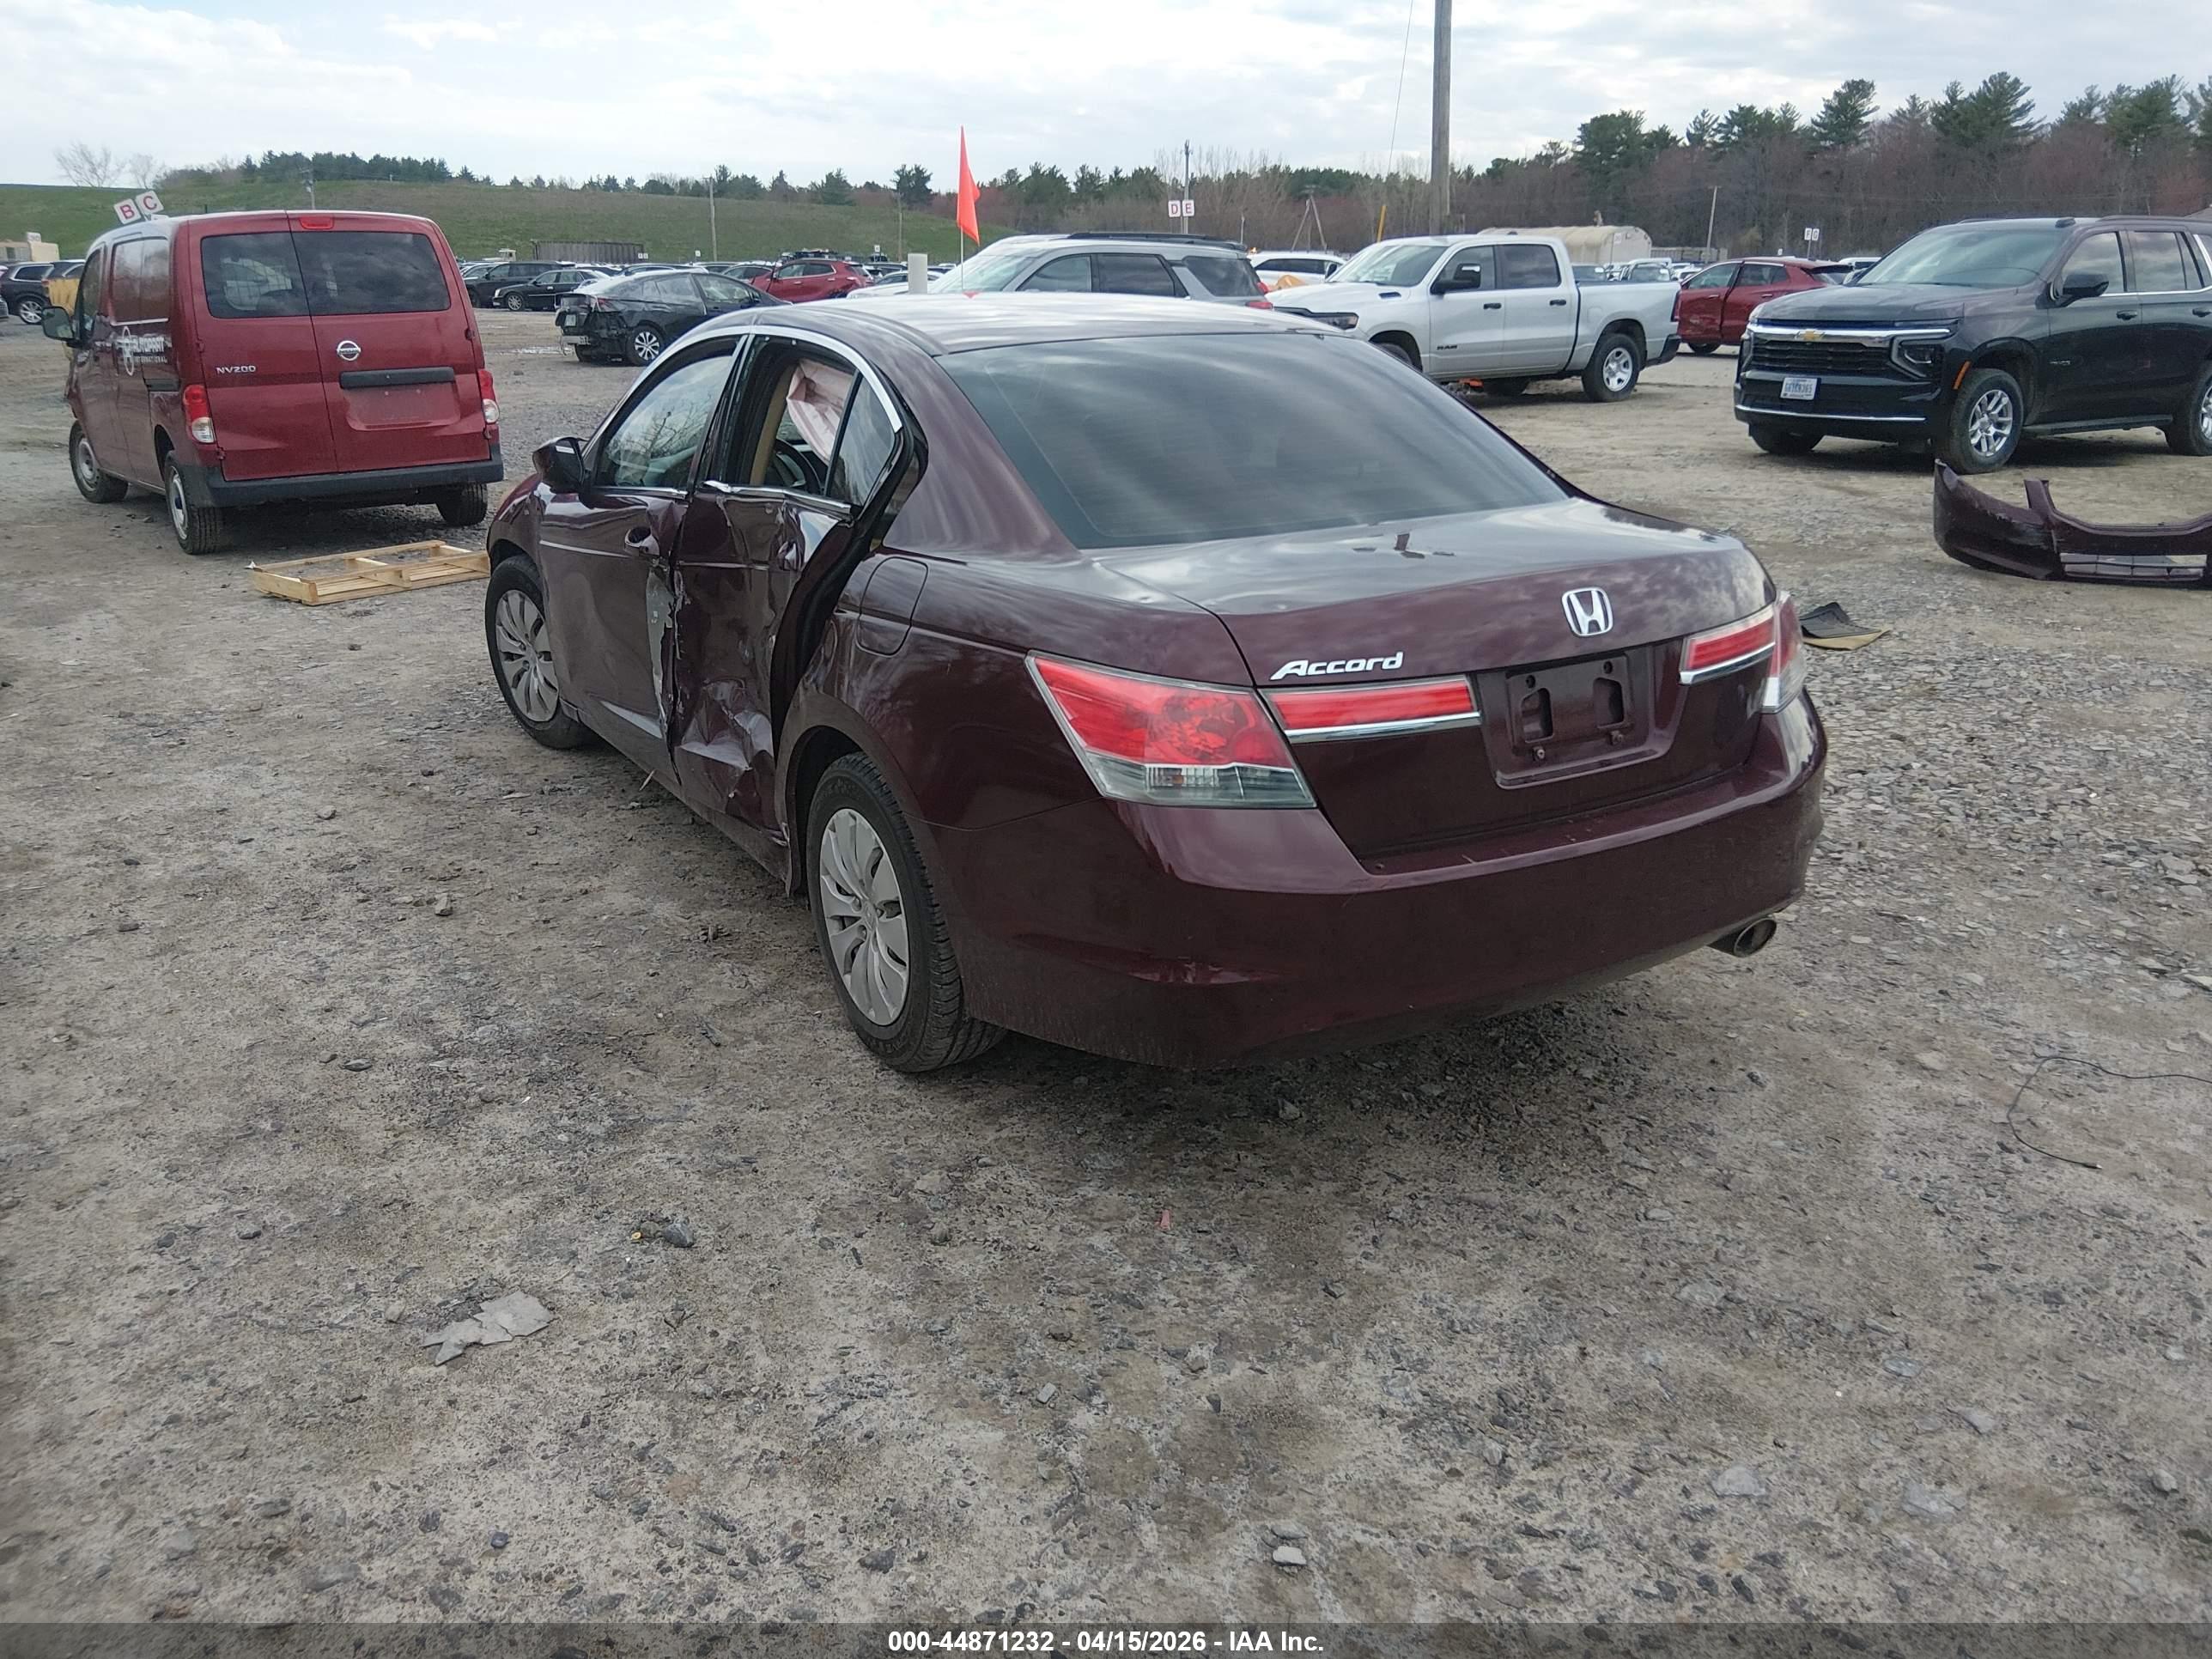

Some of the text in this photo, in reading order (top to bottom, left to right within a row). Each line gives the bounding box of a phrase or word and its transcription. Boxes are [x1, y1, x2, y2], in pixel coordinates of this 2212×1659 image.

[120, 196, 157, 219] B C
[1171, 203, 1192, 214] D E
[216, 366, 257, 374] NV200
[1269, 651, 1404, 681] Accord
